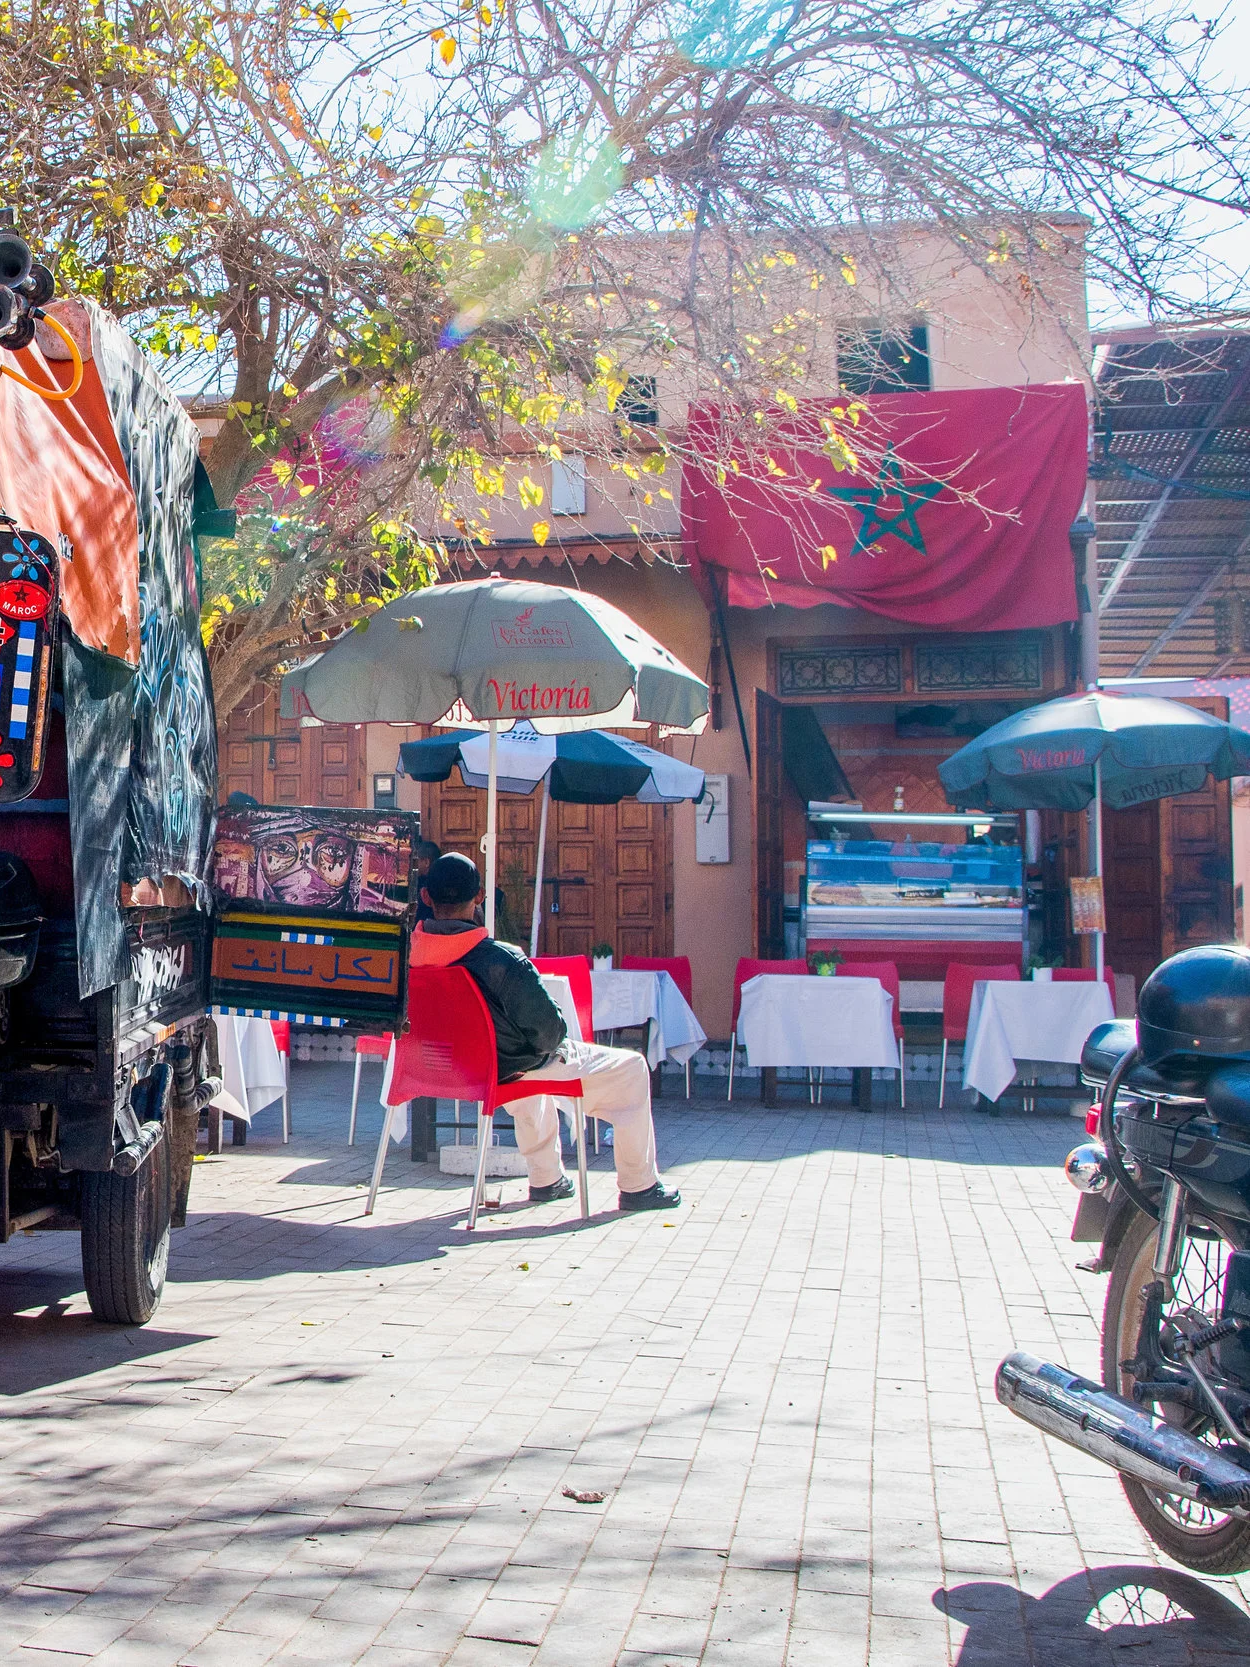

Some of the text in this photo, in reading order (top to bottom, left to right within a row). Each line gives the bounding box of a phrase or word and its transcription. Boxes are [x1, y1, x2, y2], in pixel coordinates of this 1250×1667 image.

[2, 601, 38, 615] MAROC
[501, 634, 566, 645] Victoria
[487, 679, 590, 711] Victoria
[1016, 746, 1085, 770] Victoria
[320, 953, 394, 984] لكل
